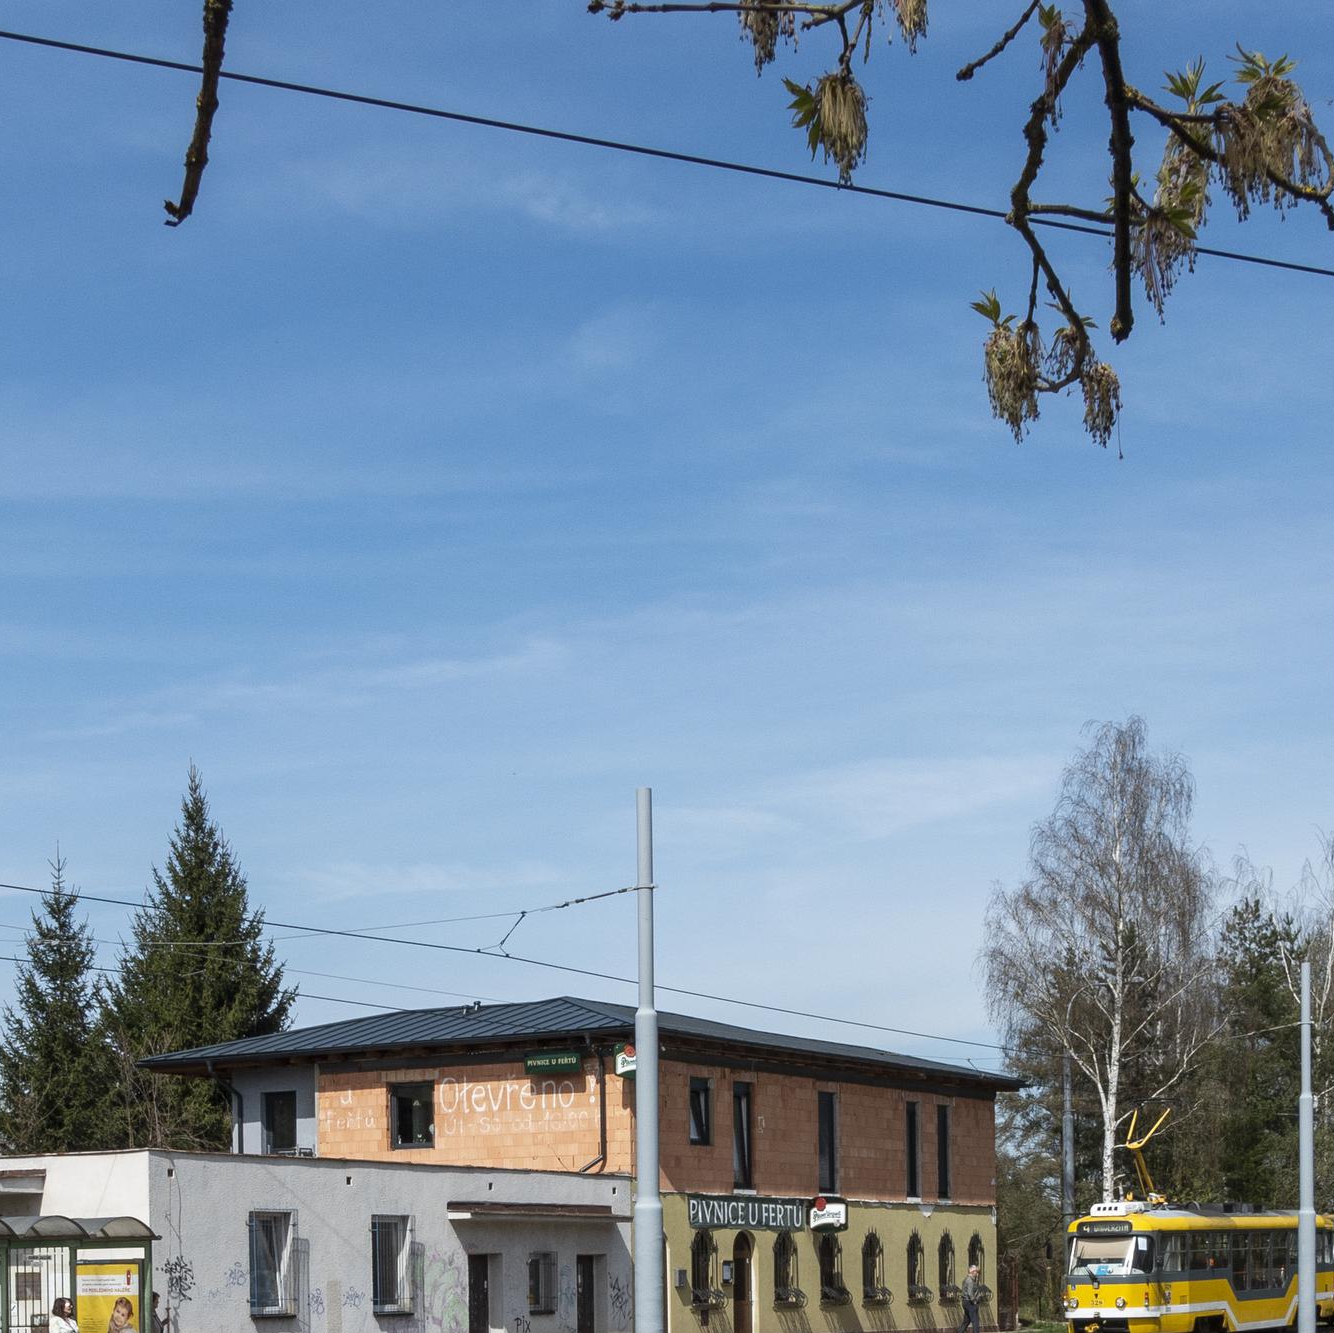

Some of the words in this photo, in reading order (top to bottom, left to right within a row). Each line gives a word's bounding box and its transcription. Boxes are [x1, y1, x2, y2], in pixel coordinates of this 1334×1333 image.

[439, 1074, 575, 1113] Otevřeno
[689, 1200, 746, 1224] PIVNICE
[749, 1202, 759, 1225] U
